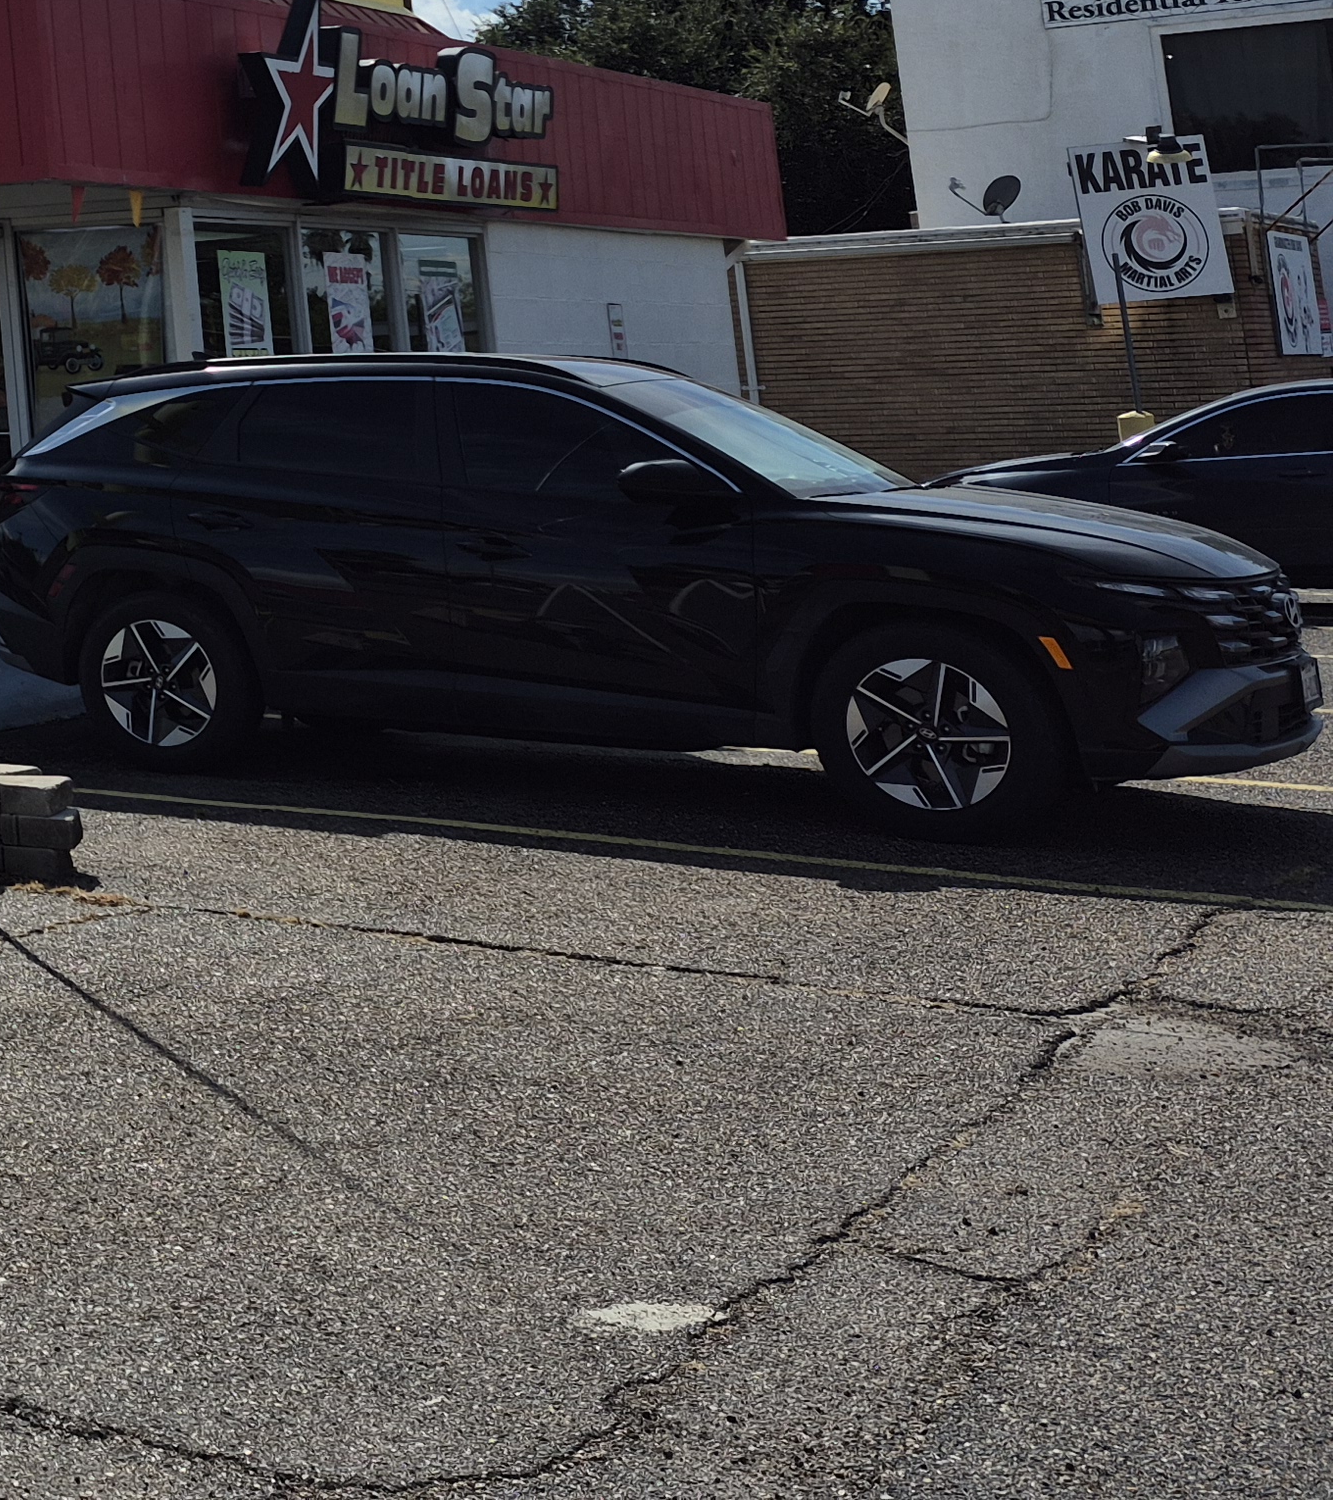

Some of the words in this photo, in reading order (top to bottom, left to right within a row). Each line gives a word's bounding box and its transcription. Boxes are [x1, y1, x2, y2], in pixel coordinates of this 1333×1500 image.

[334, 31, 447, 127] Loan
[455, 52, 551, 142] Star
[375, 155, 445, 195] TITLE
[457, 166, 533, 203] LOANS
[1115, 200, 1143, 222] BOB
[1145, 198, 1185, 219] DAVIS
[1120, 261, 1175, 288] MARTIAL
[1176, 255, 1203, 283] ARTS
